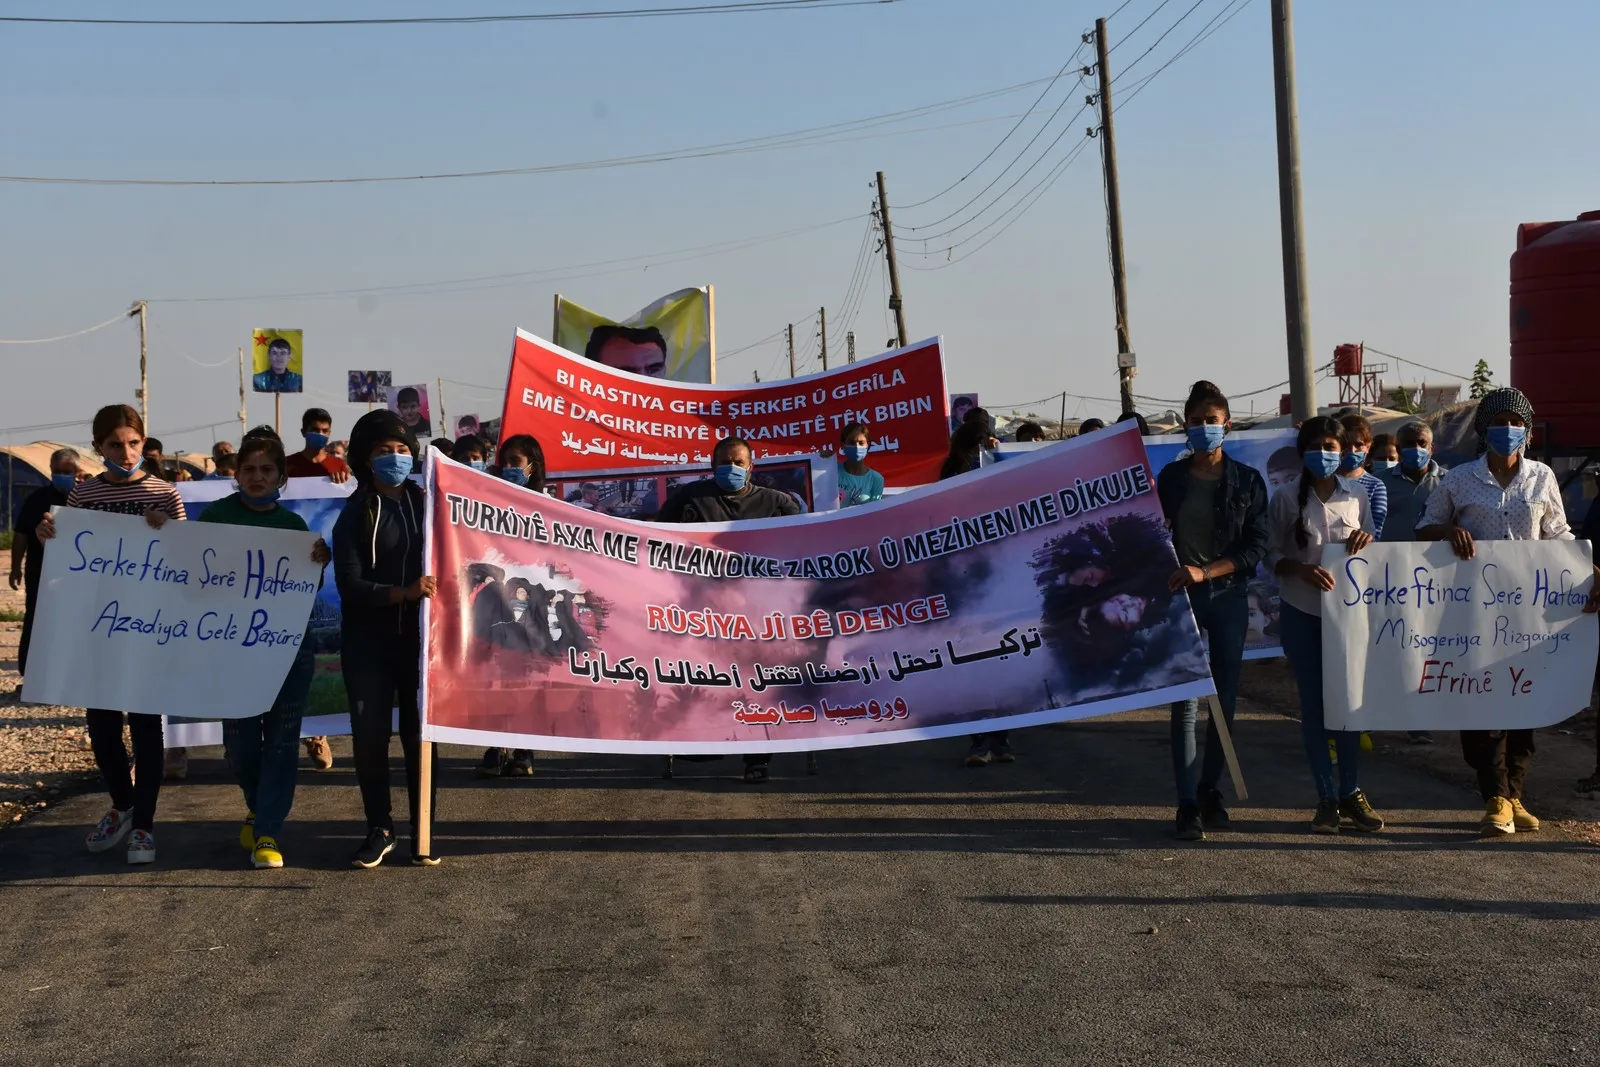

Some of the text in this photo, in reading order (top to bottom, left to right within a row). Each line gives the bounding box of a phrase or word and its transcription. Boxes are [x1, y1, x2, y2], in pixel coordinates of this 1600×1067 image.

[556, 368, 906, 420] BI RASTIYA GELÊ ŞERKER Û GERÎLA
[522, 387, 566, 416] EMÊ
[570, 402, 709, 440] DAGIRKERIYÊ
[715, 425, 730, 441] Û
[830, 408, 871, 430] TÊK
[875, 395, 933, 423] BIBIN
[551, 522, 601, 554] AXA
[601, 530, 639, 564] ME
[646, 538, 724, 576] TALAN
[724, 550, 783, 580] DİKE
[783, 547, 874, 580] ZAROK
[878, 537, 899, 569] Û
[902, 506, 1018, 564] MEZİNEN
[1019, 497, 1059, 532] ME
[1058, 463, 1151, 519] DİKUJE
[69, 530, 189, 585] Serkeftina
[198, 548, 237, 589] Şerê
[1344, 557, 1471, 608] Serkeftina
[197, 611, 238, 641] Gelê
[645, 594, 951, 642] RÛSİYA JÎ BÊ DENGE
[1376, 618, 1481, 657] Misogeriya
[568, 646, 650, 690] وكبارنا
[653, 657, 742, 689] أطفالنا
[750, 663, 803, 692] تقتل
[806, 656, 881, 685] أرضنا
[888, 648, 943, 682] تحتل
[1418, 660, 1533, 696] Efrînê Ye
[731, 695, 910, 725] وروسيا صامتة
